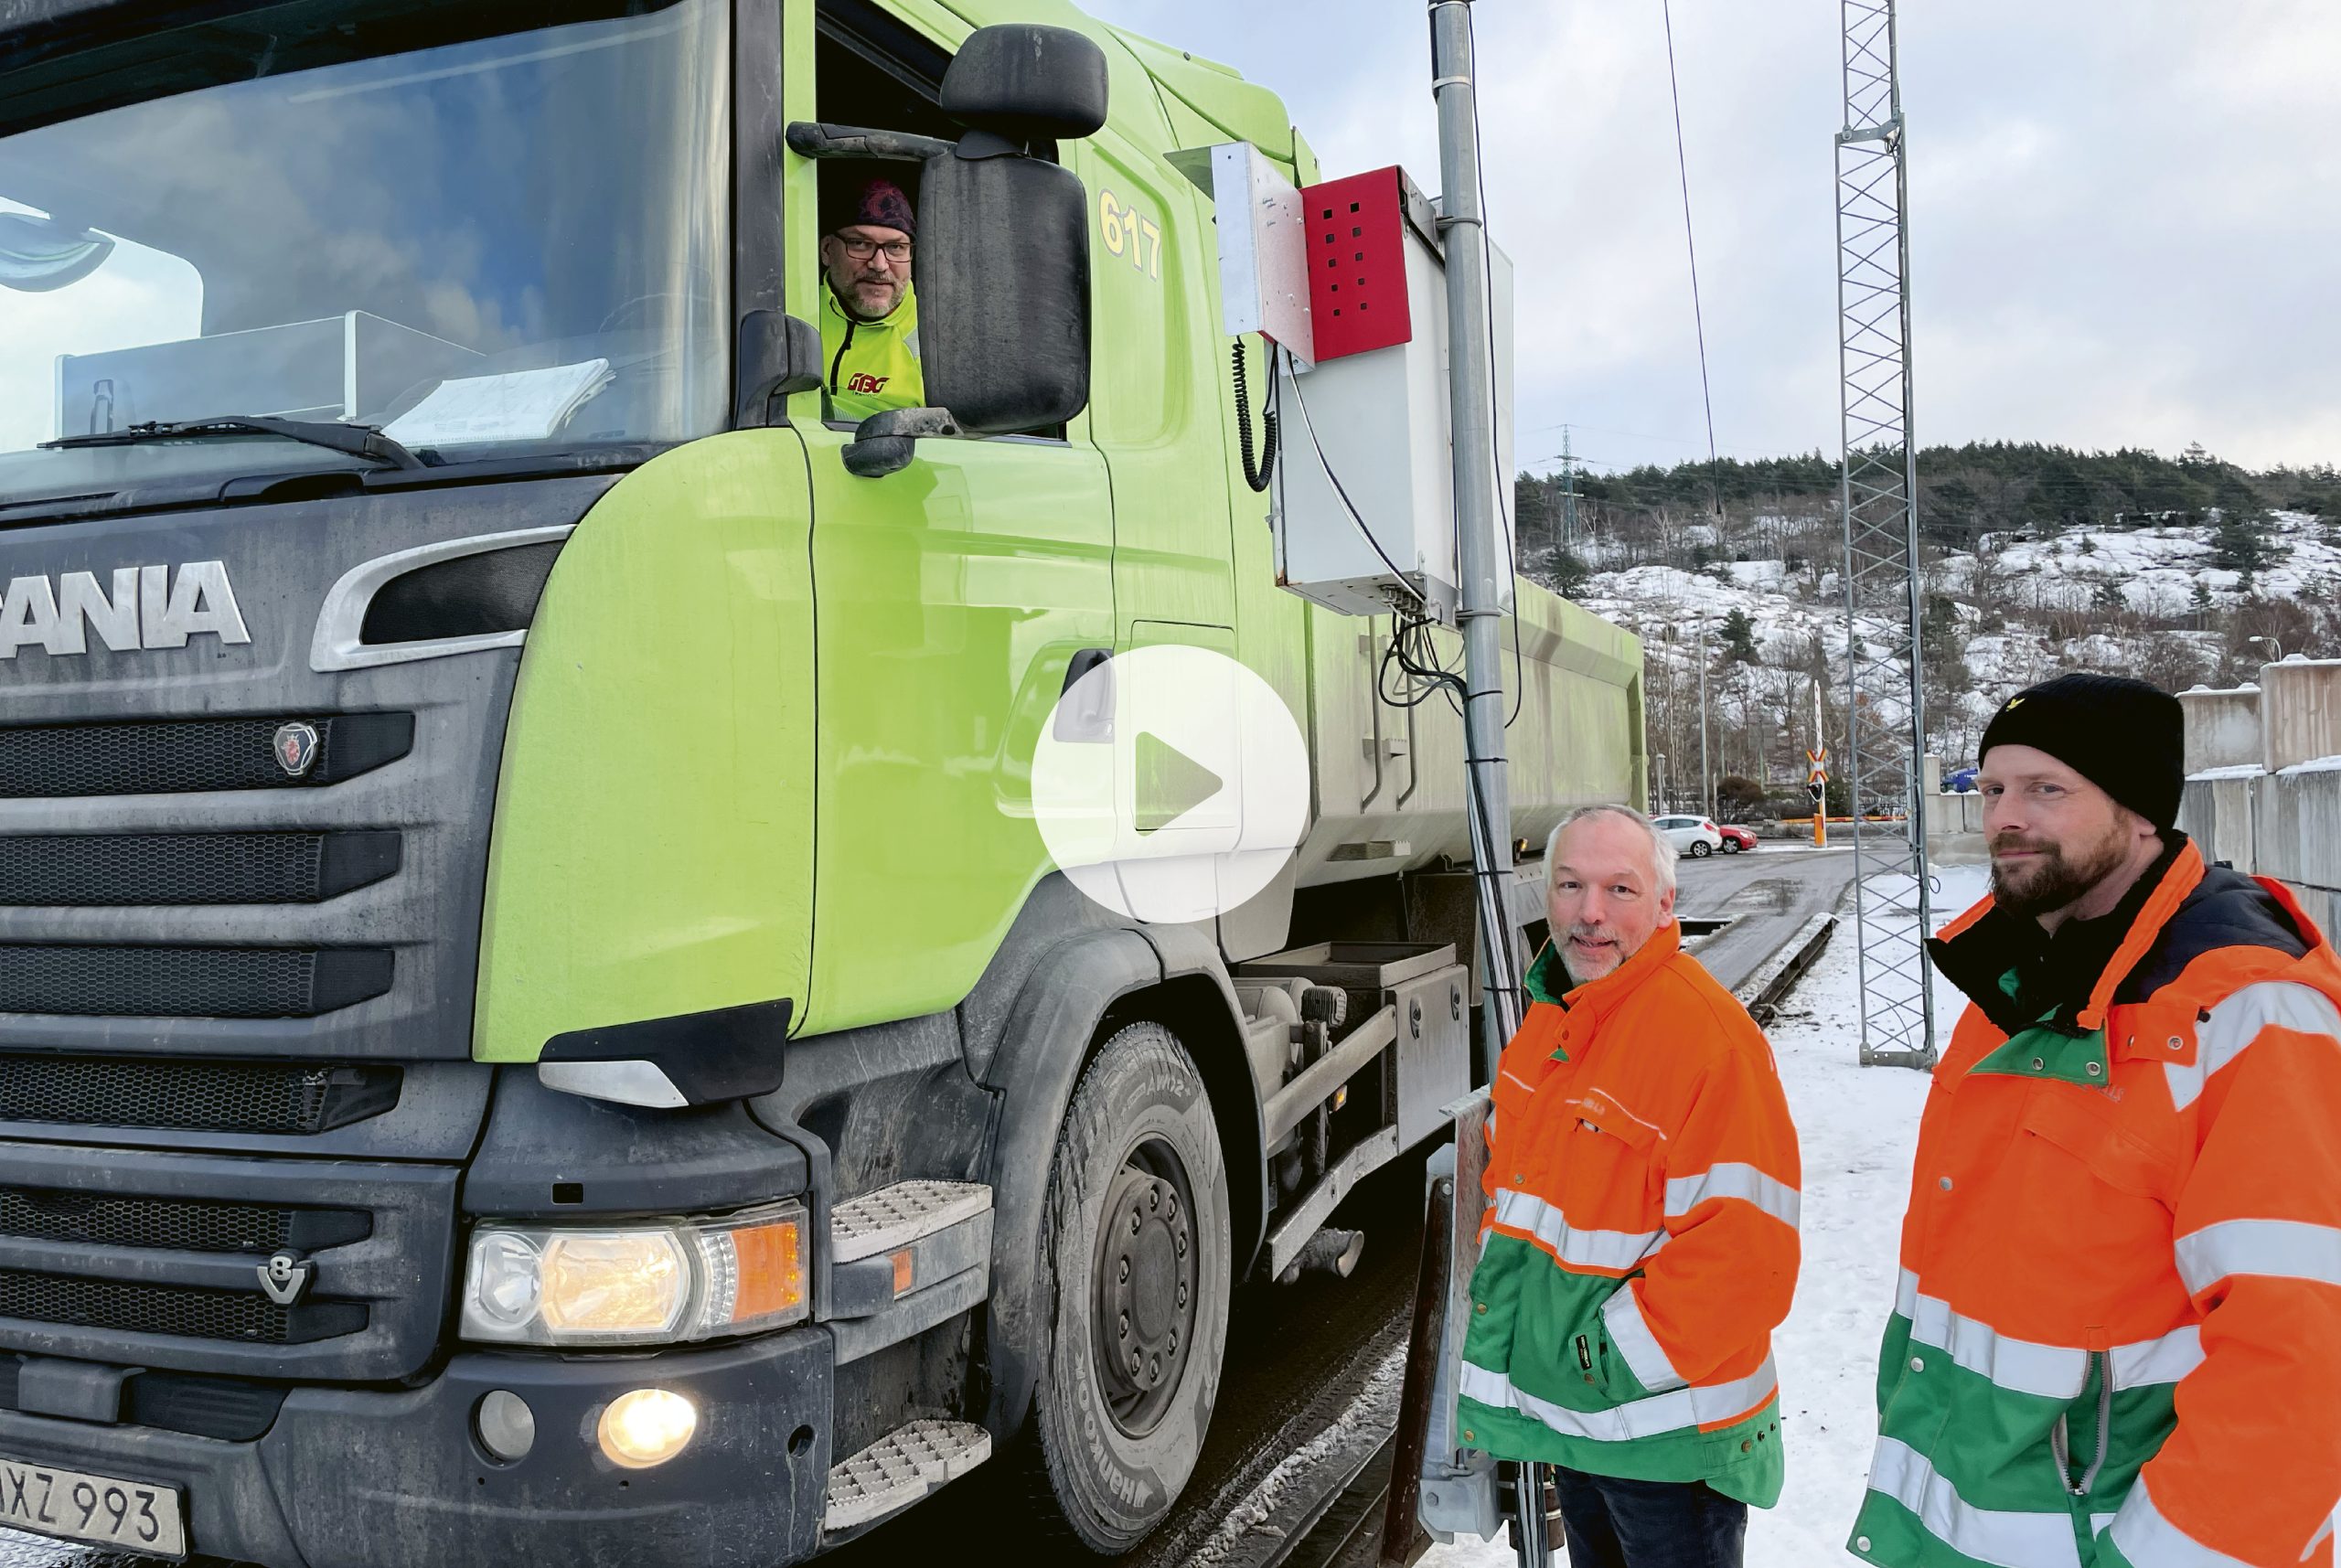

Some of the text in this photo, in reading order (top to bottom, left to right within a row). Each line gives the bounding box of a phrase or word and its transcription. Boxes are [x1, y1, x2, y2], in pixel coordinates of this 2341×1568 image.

[1098, 187, 1161, 283] 617
[847, 372, 891, 394] GBG
[0, 560, 251, 659] ANIA
[0, 1467, 160, 1542] XZ 993
